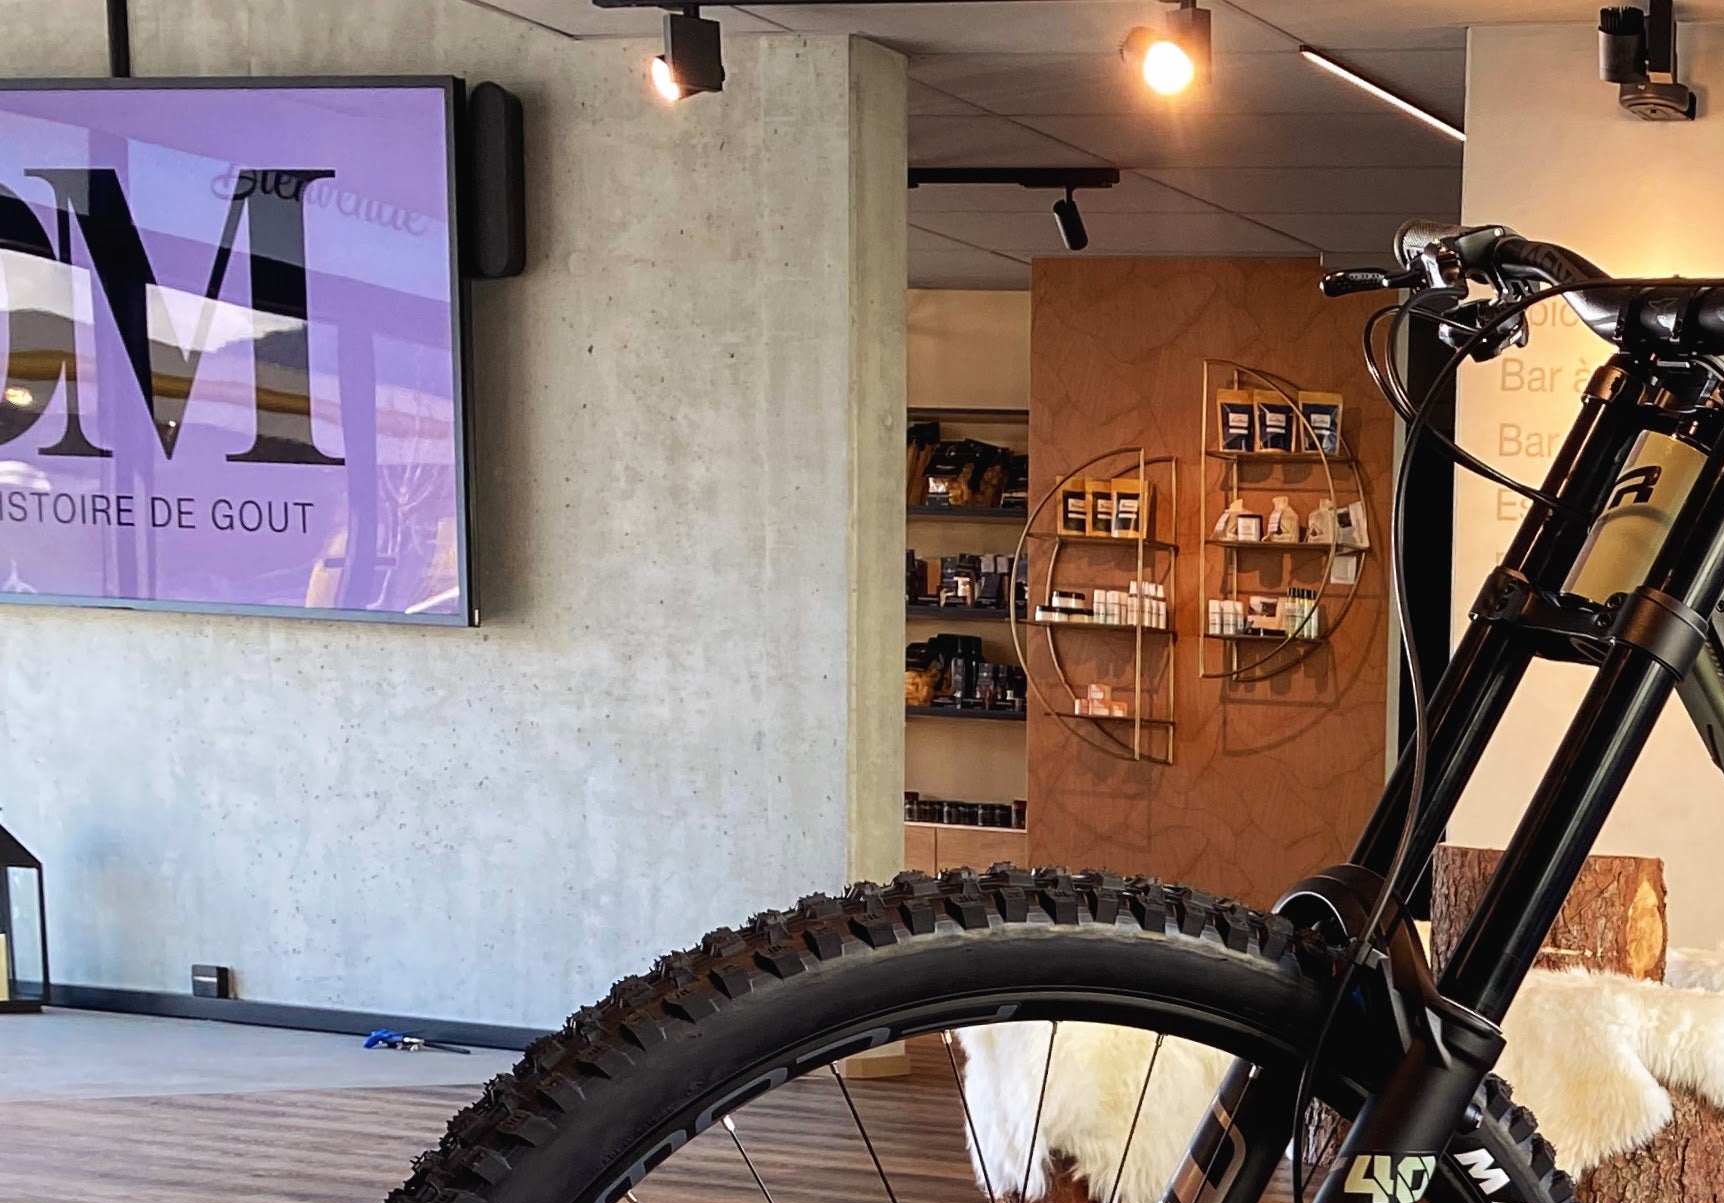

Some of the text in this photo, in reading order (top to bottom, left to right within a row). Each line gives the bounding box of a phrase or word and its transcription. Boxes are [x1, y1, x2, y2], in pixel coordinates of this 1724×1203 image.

[1500, 357, 1562, 392] Bar
[1499, 423, 1561, 457] Bar
[151, 497, 197, 530] DE
[211, 500, 315, 534] GOUT
